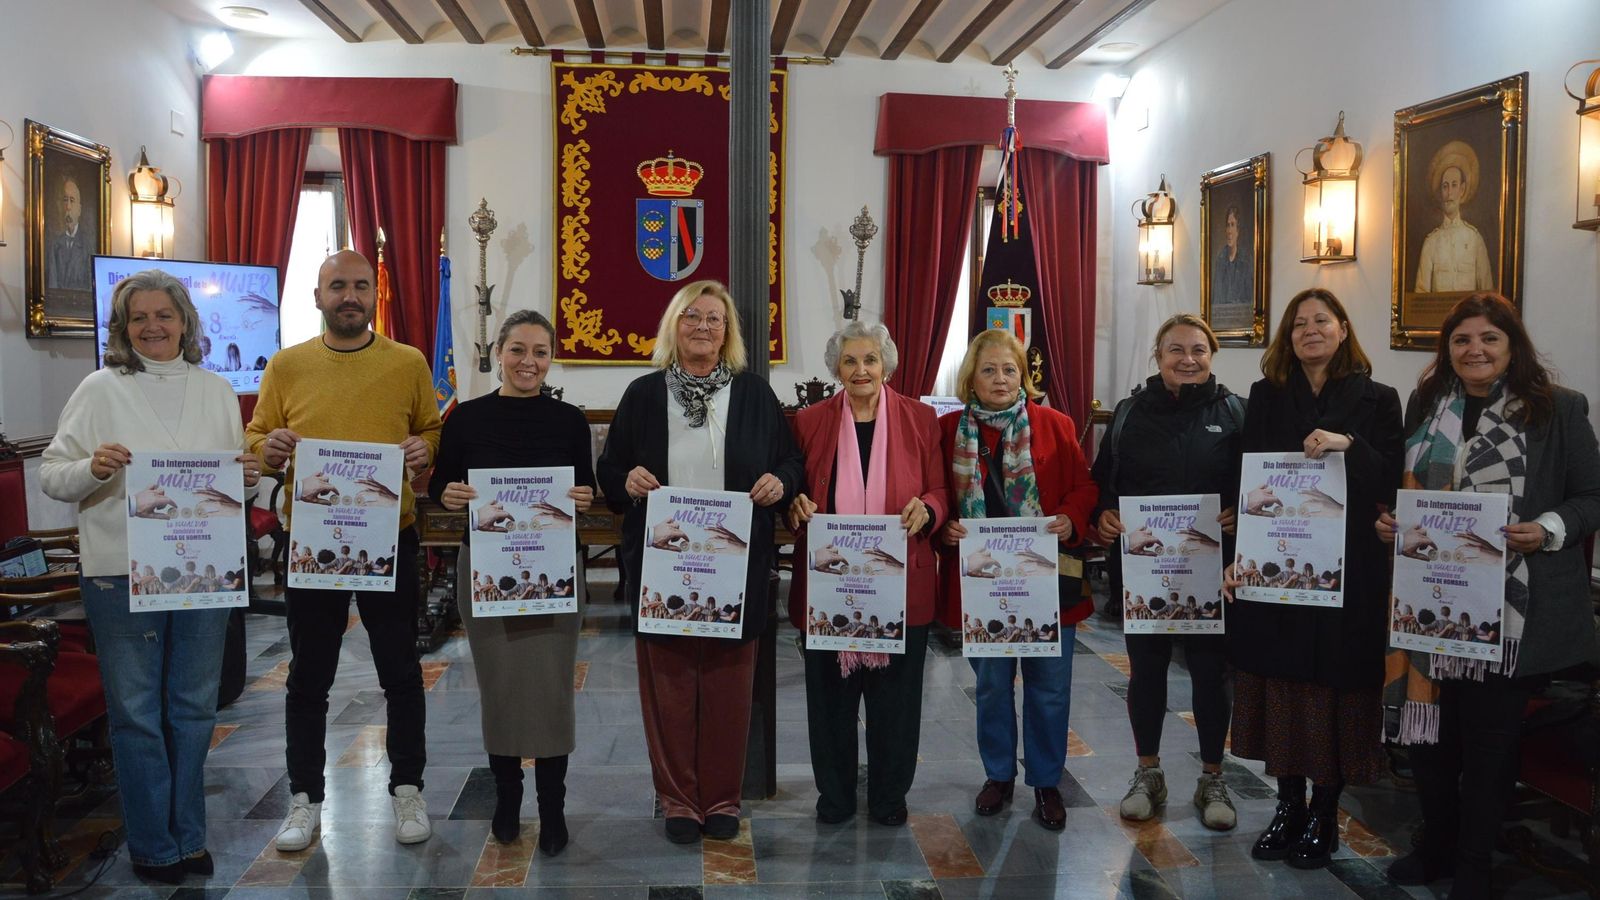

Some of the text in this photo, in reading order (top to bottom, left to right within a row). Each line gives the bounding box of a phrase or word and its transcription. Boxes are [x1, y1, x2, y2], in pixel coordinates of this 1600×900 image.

[208, 272, 270, 297] MUJER
[210, 312, 221, 333] 8
[319, 448, 382, 460] Día Internacional
[152, 459, 220, 468] Día Internacional
[1263, 461, 1325, 470] Día Internacional
[322, 463, 377, 478] MUJER
[157, 474, 217, 488] MUJER
[504, 476, 552, 484] Internacional
[1267, 475, 1321, 489] MUJER
[496, 490, 549, 503] MUJER
[670, 496, 731, 508] Día Internacional
[1417, 499, 1482, 511] Día Internacional
[673, 510, 727, 527] MUJER
[1145, 516, 1197, 529] MUJER
[1420, 515, 1477, 532] MUJER
[333, 527, 342, 539] 8
[840, 523, 886, 531] Internacional
[176, 542, 185, 555] 8
[831, 536, 883, 549] MUJER
[985, 538, 1034, 550] MUJER
[1278, 540, 1286, 552] 8
[512, 553, 521, 565] 8
[682, 574, 691, 586] 8
[1162, 576, 1170, 587] 8
[1433, 585, 1441, 599] 8
[845, 595, 853, 606] 8
[999, 598, 1007, 610] 8
